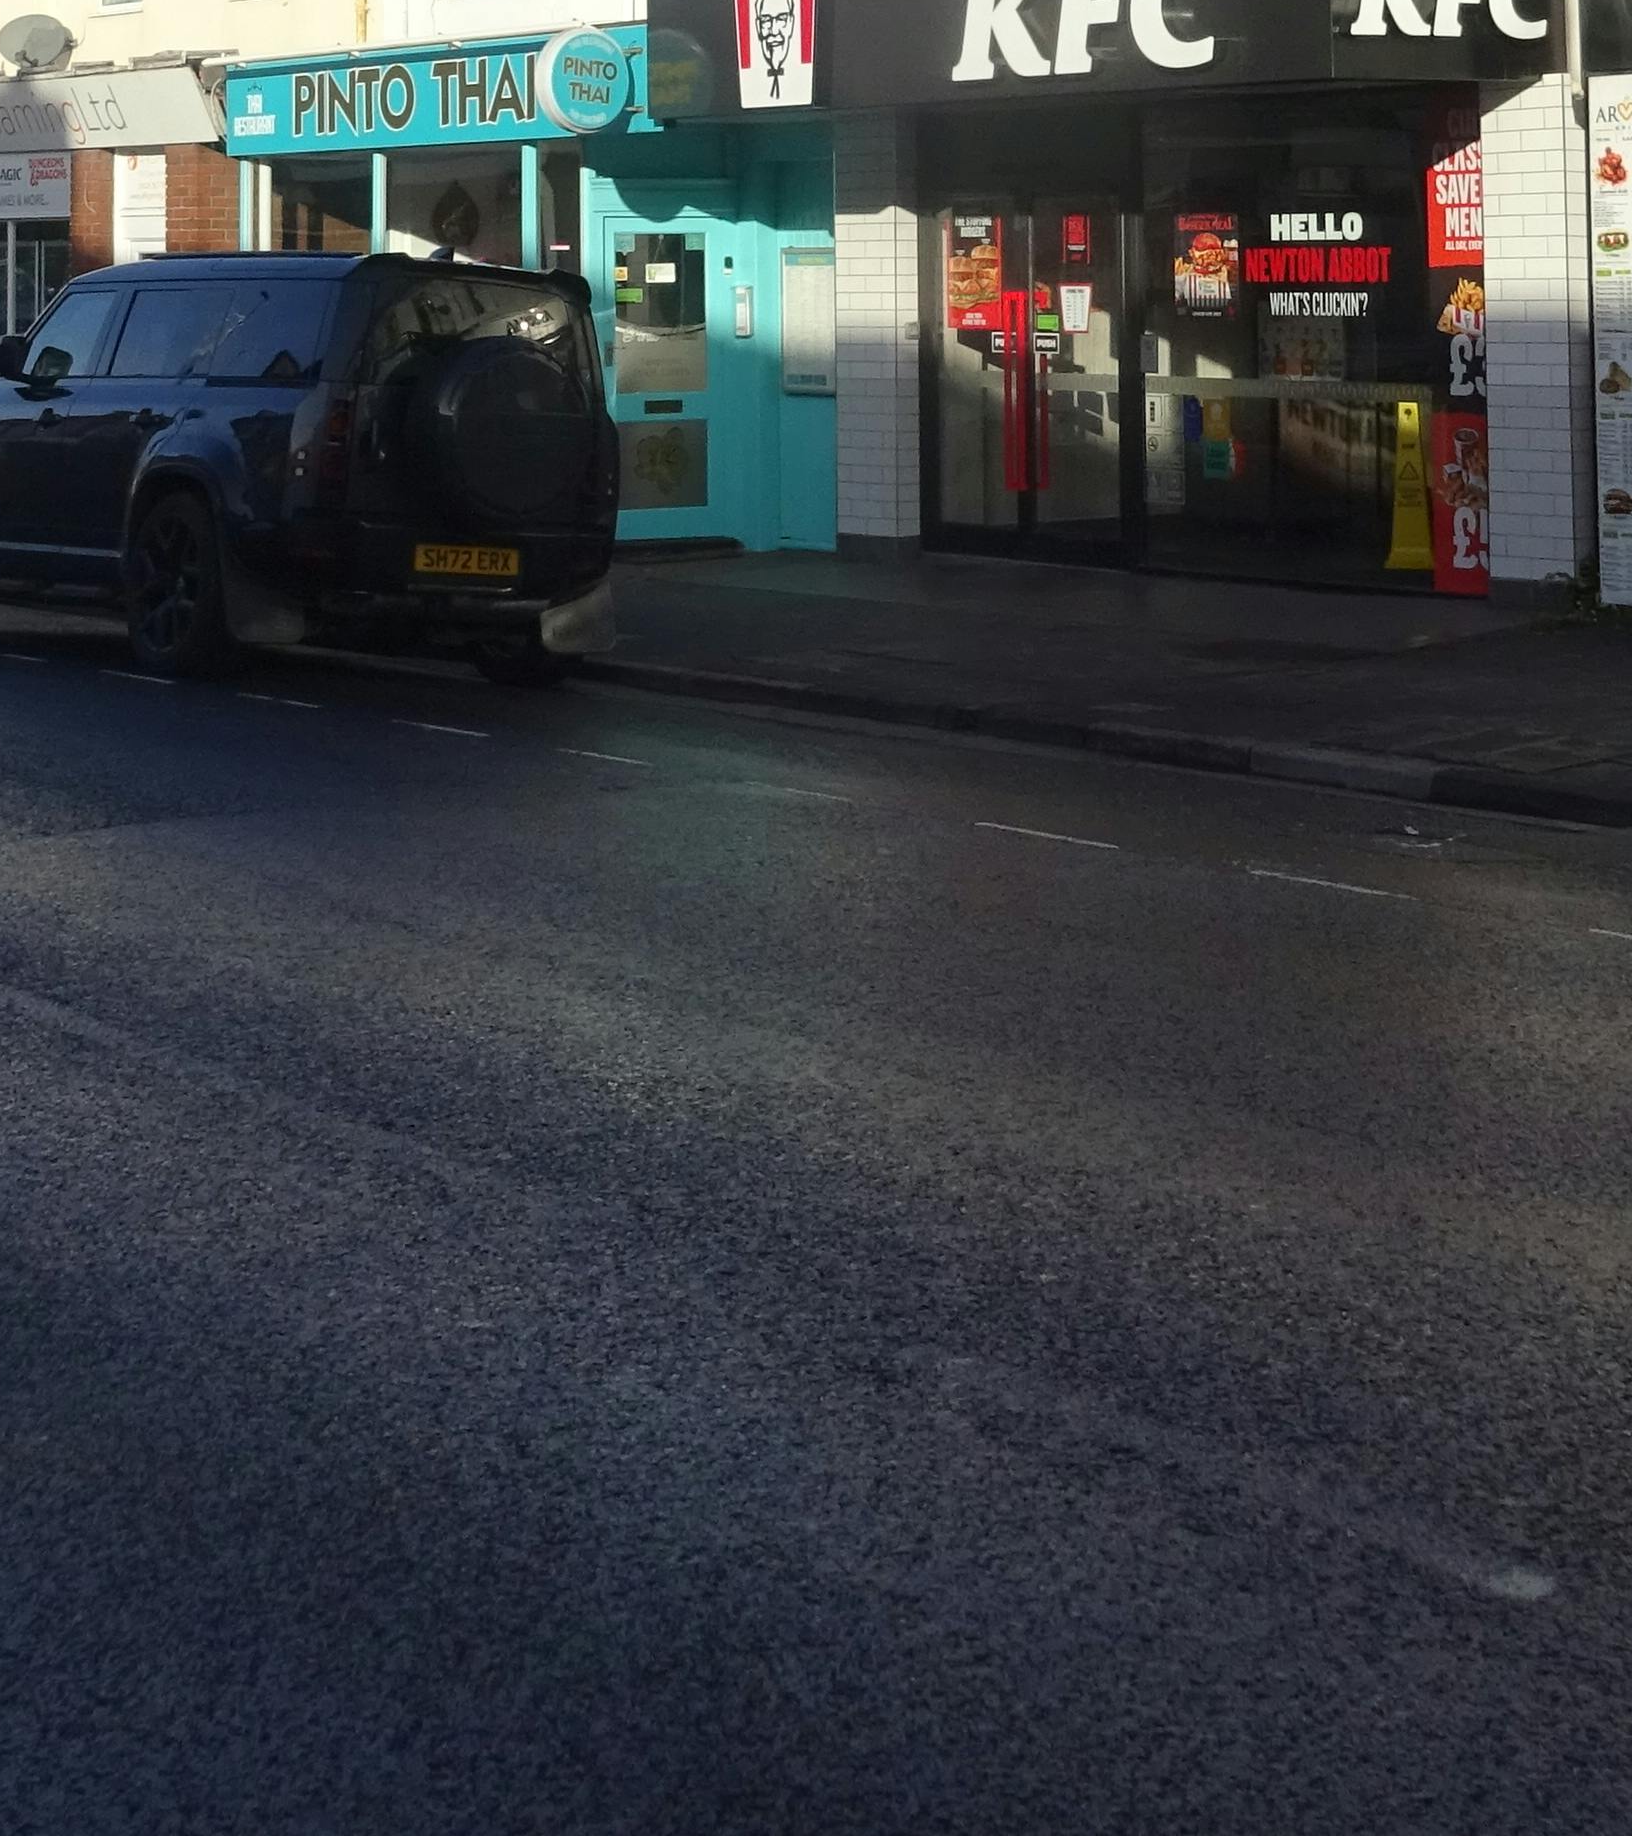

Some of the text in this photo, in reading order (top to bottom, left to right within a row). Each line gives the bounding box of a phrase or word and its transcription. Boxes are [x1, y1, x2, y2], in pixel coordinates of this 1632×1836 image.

[563, 56, 617, 81] PINTO
[292, 51, 536, 137] PINTO THAI
[569, 81, 610, 104] THAI
[1270, 212, 1363, 242] HELLO
[1245, 246, 1392, 284] NEWTON ABBOT
[1269, 291, 1369, 317] WHAT'S CLUCKIN'?
[423, 549, 512, 572] SH72 ERX
